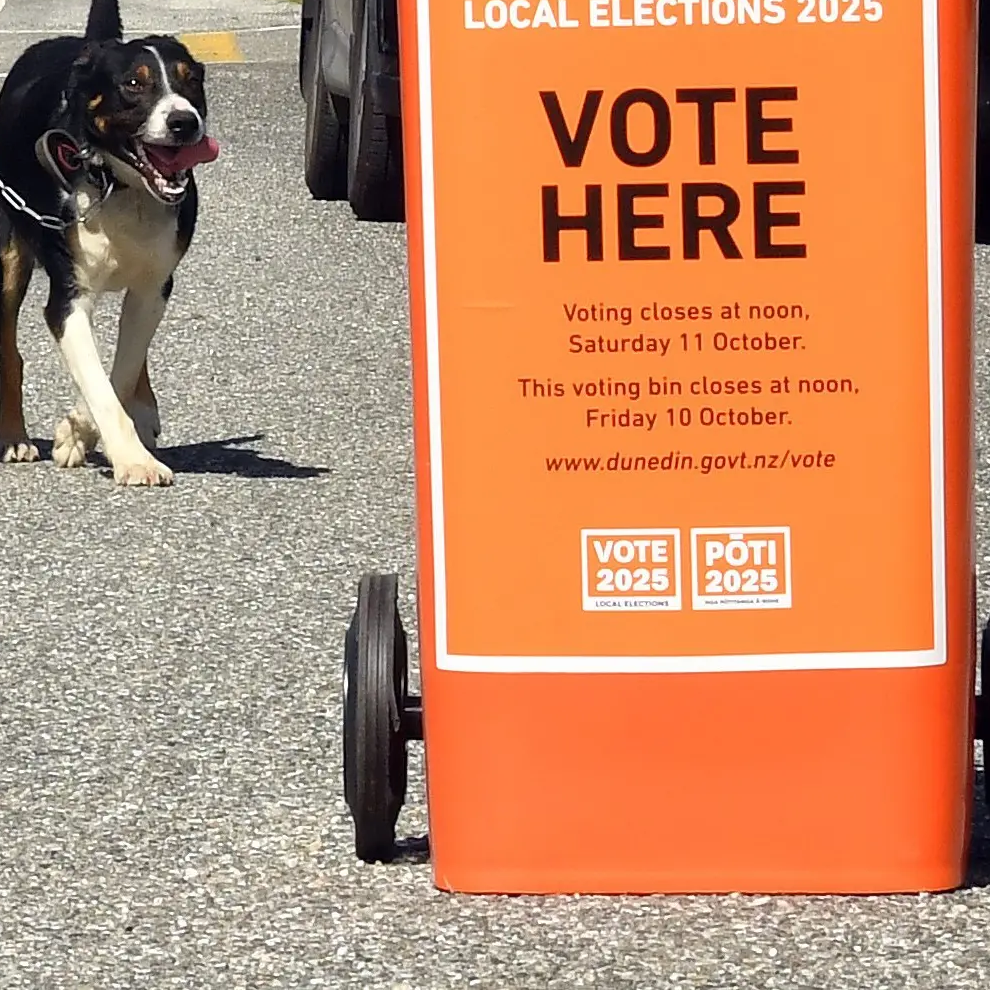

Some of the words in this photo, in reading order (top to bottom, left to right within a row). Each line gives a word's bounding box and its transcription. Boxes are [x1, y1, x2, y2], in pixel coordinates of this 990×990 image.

[539, 86, 799, 168] VOTE
[541, 181, 808, 262] HERE
[563, 302, 632, 326] Voting
[640, 302, 713, 321] closes
[720, 302, 741, 320] at
[748, 304, 810, 322] noon,
[568, 334, 671, 357] Saturday
[680, 333, 702, 352] 11
[713, 331, 806, 352] October.
[518, 378, 566, 397] This
[572, 377, 641, 401] voting
[649, 376, 682, 396] bin
[689, 375, 763, 395] closes
[769, 376, 791, 394] at
[798, 377, 860, 395] noon,
[586, 409, 658, 432] Friday
[666, 408, 692, 427] 10
[699, 406, 793, 427] October.
[545, 449, 836, 475] www.dunedin.govt.nz/vote
[593, 540, 669, 564] VOTE
[705, 534, 777, 566] PŌTI
[596, 568, 670, 592] 2025
[705, 569, 779, 593] 2025
[595, 600, 622, 608] LOCAL
